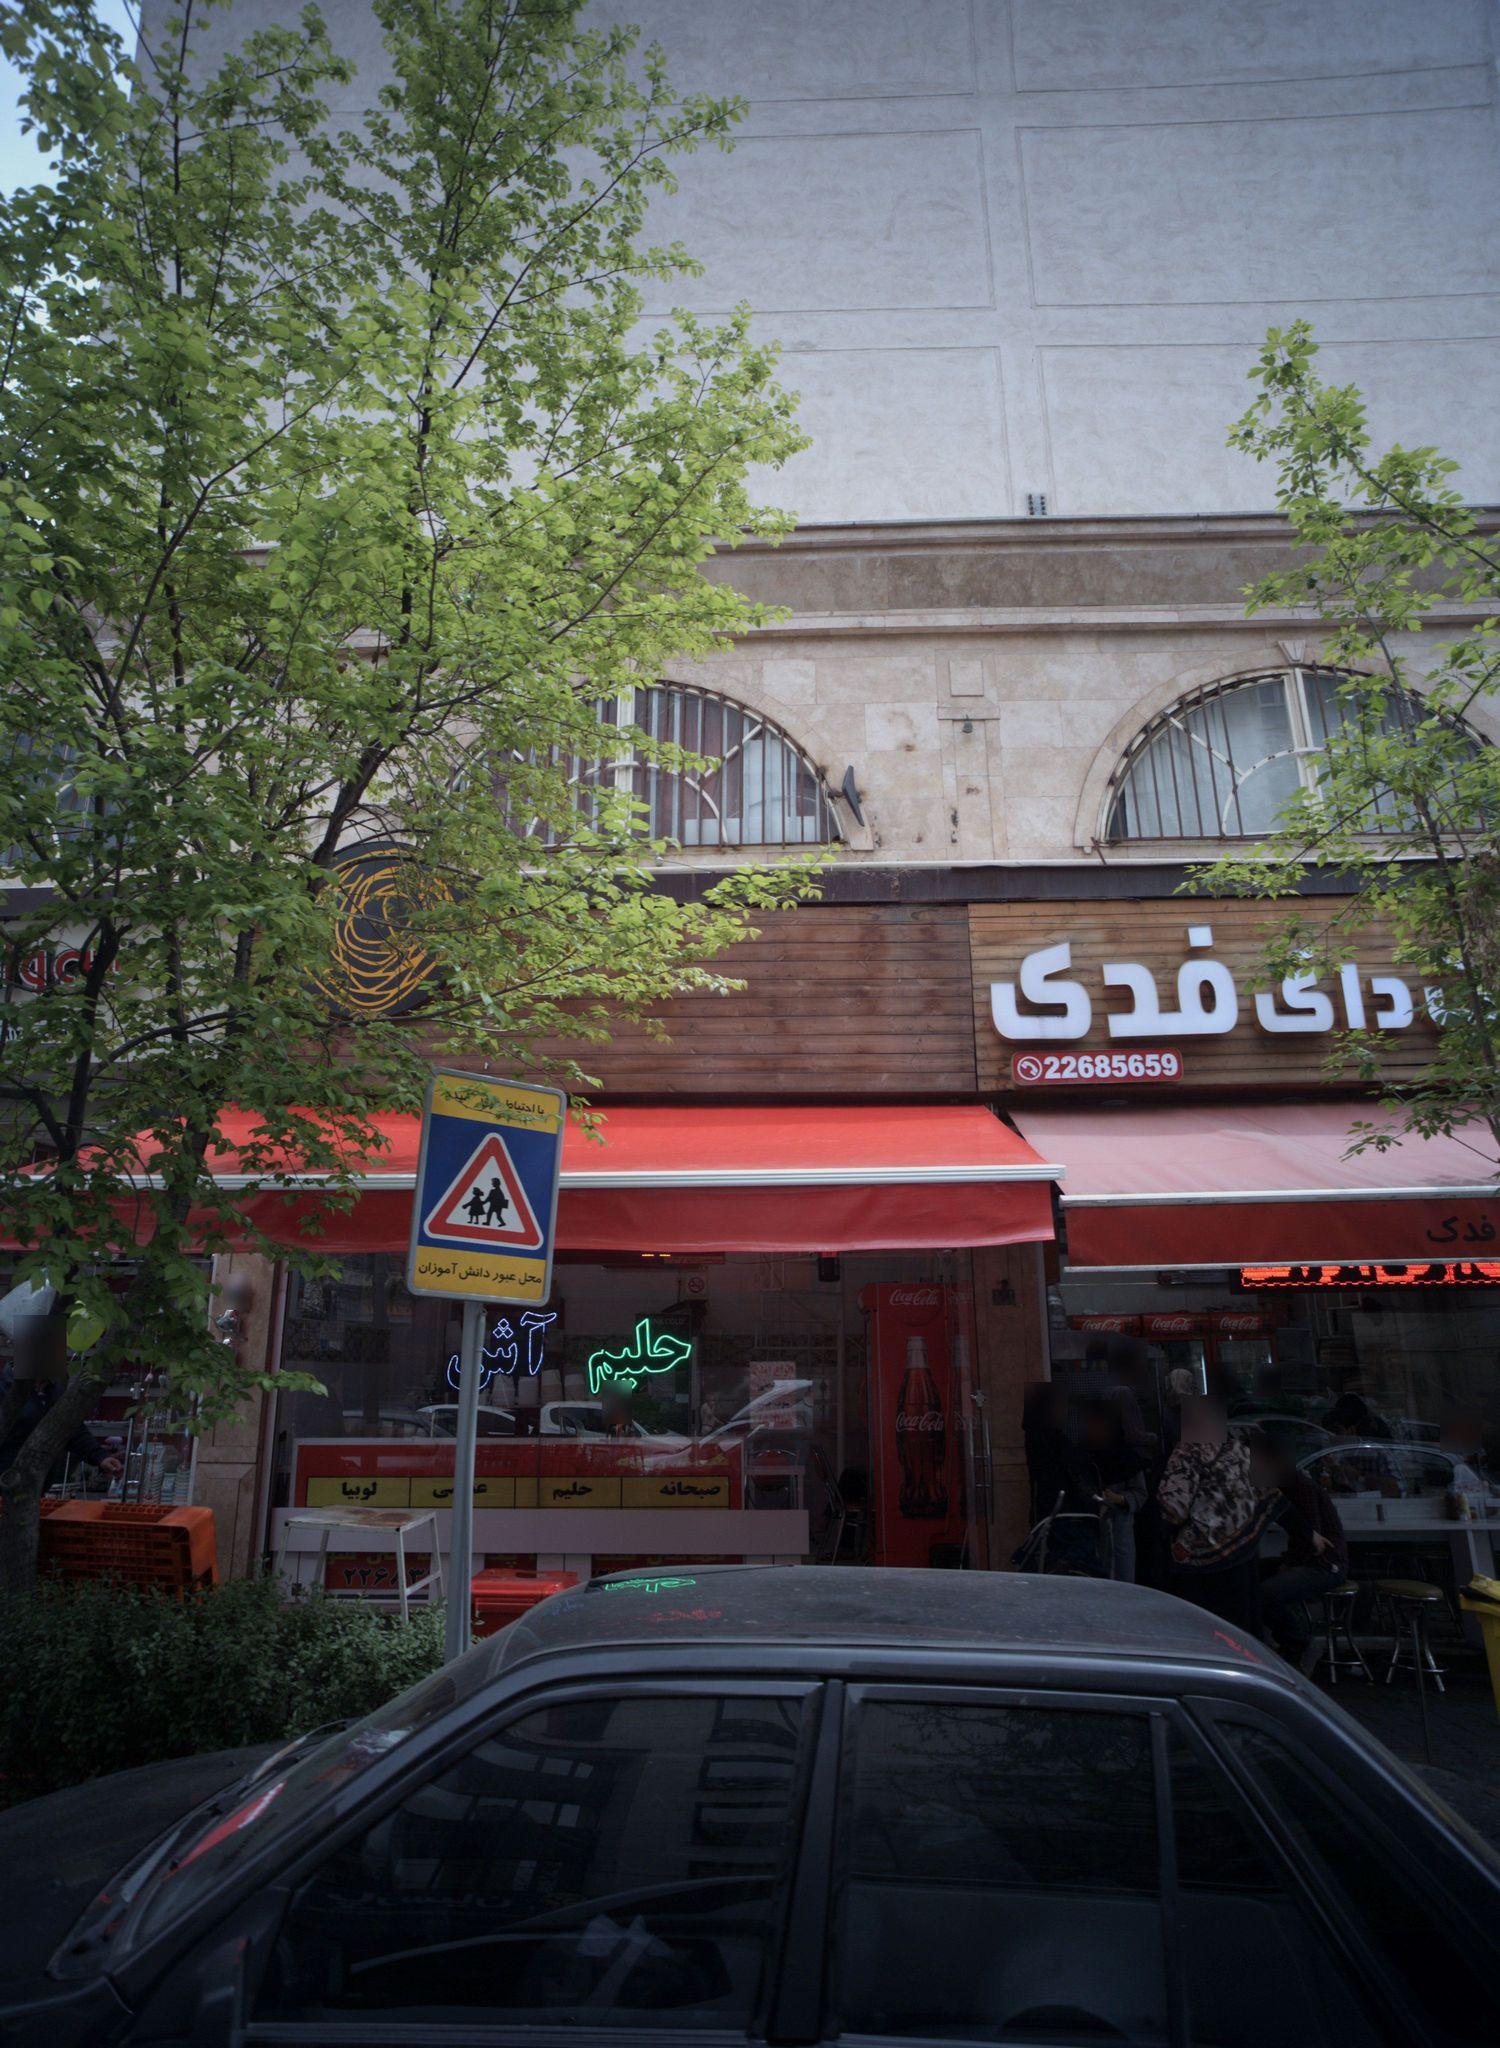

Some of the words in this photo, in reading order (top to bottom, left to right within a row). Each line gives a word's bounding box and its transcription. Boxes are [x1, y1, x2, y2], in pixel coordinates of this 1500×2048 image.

[991, 925, 1239, 1040] فدک
[1044, 1053, 1179, 1080] 22685659
[1427, 1214, 1497, 1244] فدک
[418, 1261, 459, 1278] آموزان
[458, 1265, 491, 1280] دانش
[492, 1271, 517, 1284] عبور
[518, 1272, 543, 1286] محل
[587, 1317, 693, 1394] حلیم
[342, 1481, 377, 1500] لوبیا
[553, 1481, 593, 1500] حلیم
[659, 1480, 721, 1500] صبحانه
